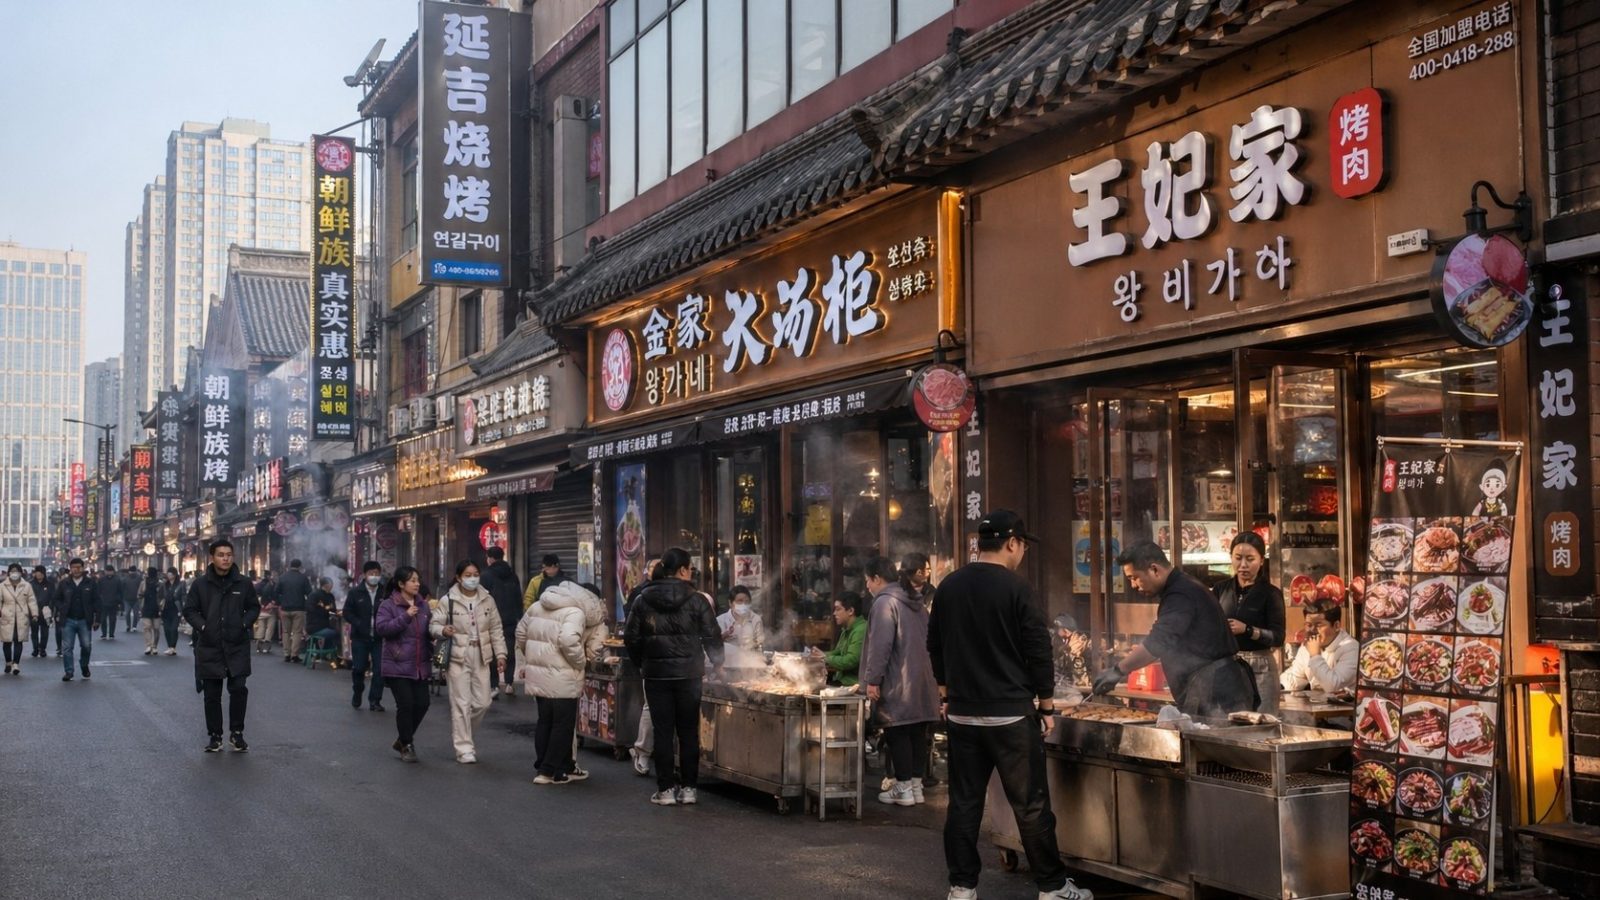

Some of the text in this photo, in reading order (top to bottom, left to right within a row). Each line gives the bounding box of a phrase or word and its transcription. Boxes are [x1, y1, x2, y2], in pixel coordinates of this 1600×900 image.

[1408, 1, 1511, 58] 全国加盟电话
[1409, 31, 1513, 80] 400-0418-288
[443, 13, 491, 223] 延吉烧烤
[1339, 103, 1370, 185] 烤肉
[1068, 105, 1304, 267] 王妃家
[642, 294, 705, 360] 金家
[645, 354, 705, 405] 왕가네
[1539, 299, 1577, 490] 王妃家
[203, 374, 230, 482] 朝鲜族烤
[966, 408, 981, 520] 王妃家
[1399, 459, 1436, 475] 王妃家
[1550, 521, 1572, 568] 烤肉
